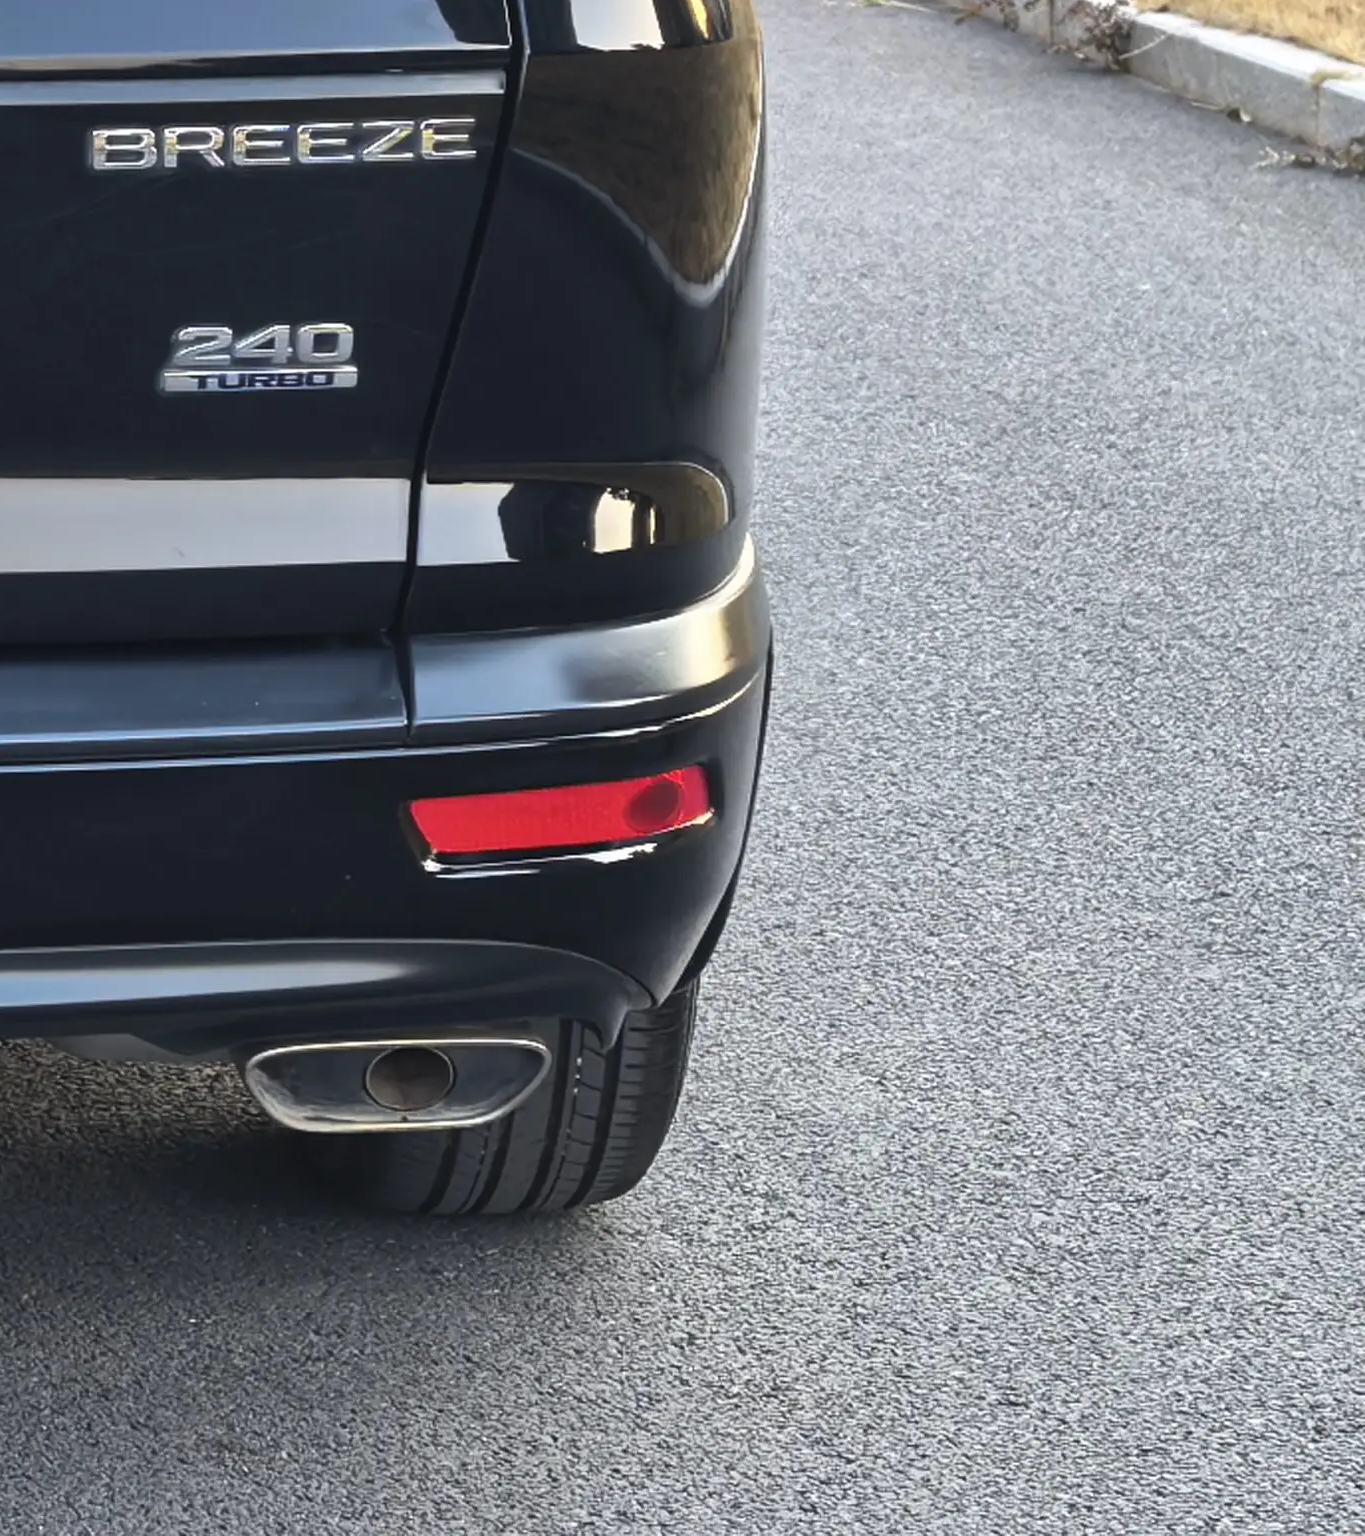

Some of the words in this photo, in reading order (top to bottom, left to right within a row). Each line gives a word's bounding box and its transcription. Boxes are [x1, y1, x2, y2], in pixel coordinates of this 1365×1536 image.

[91, 118, 477, 170] BREEZE
[170, 322, 355, 365] 240
[187, 371, 334, 390] TURBO
